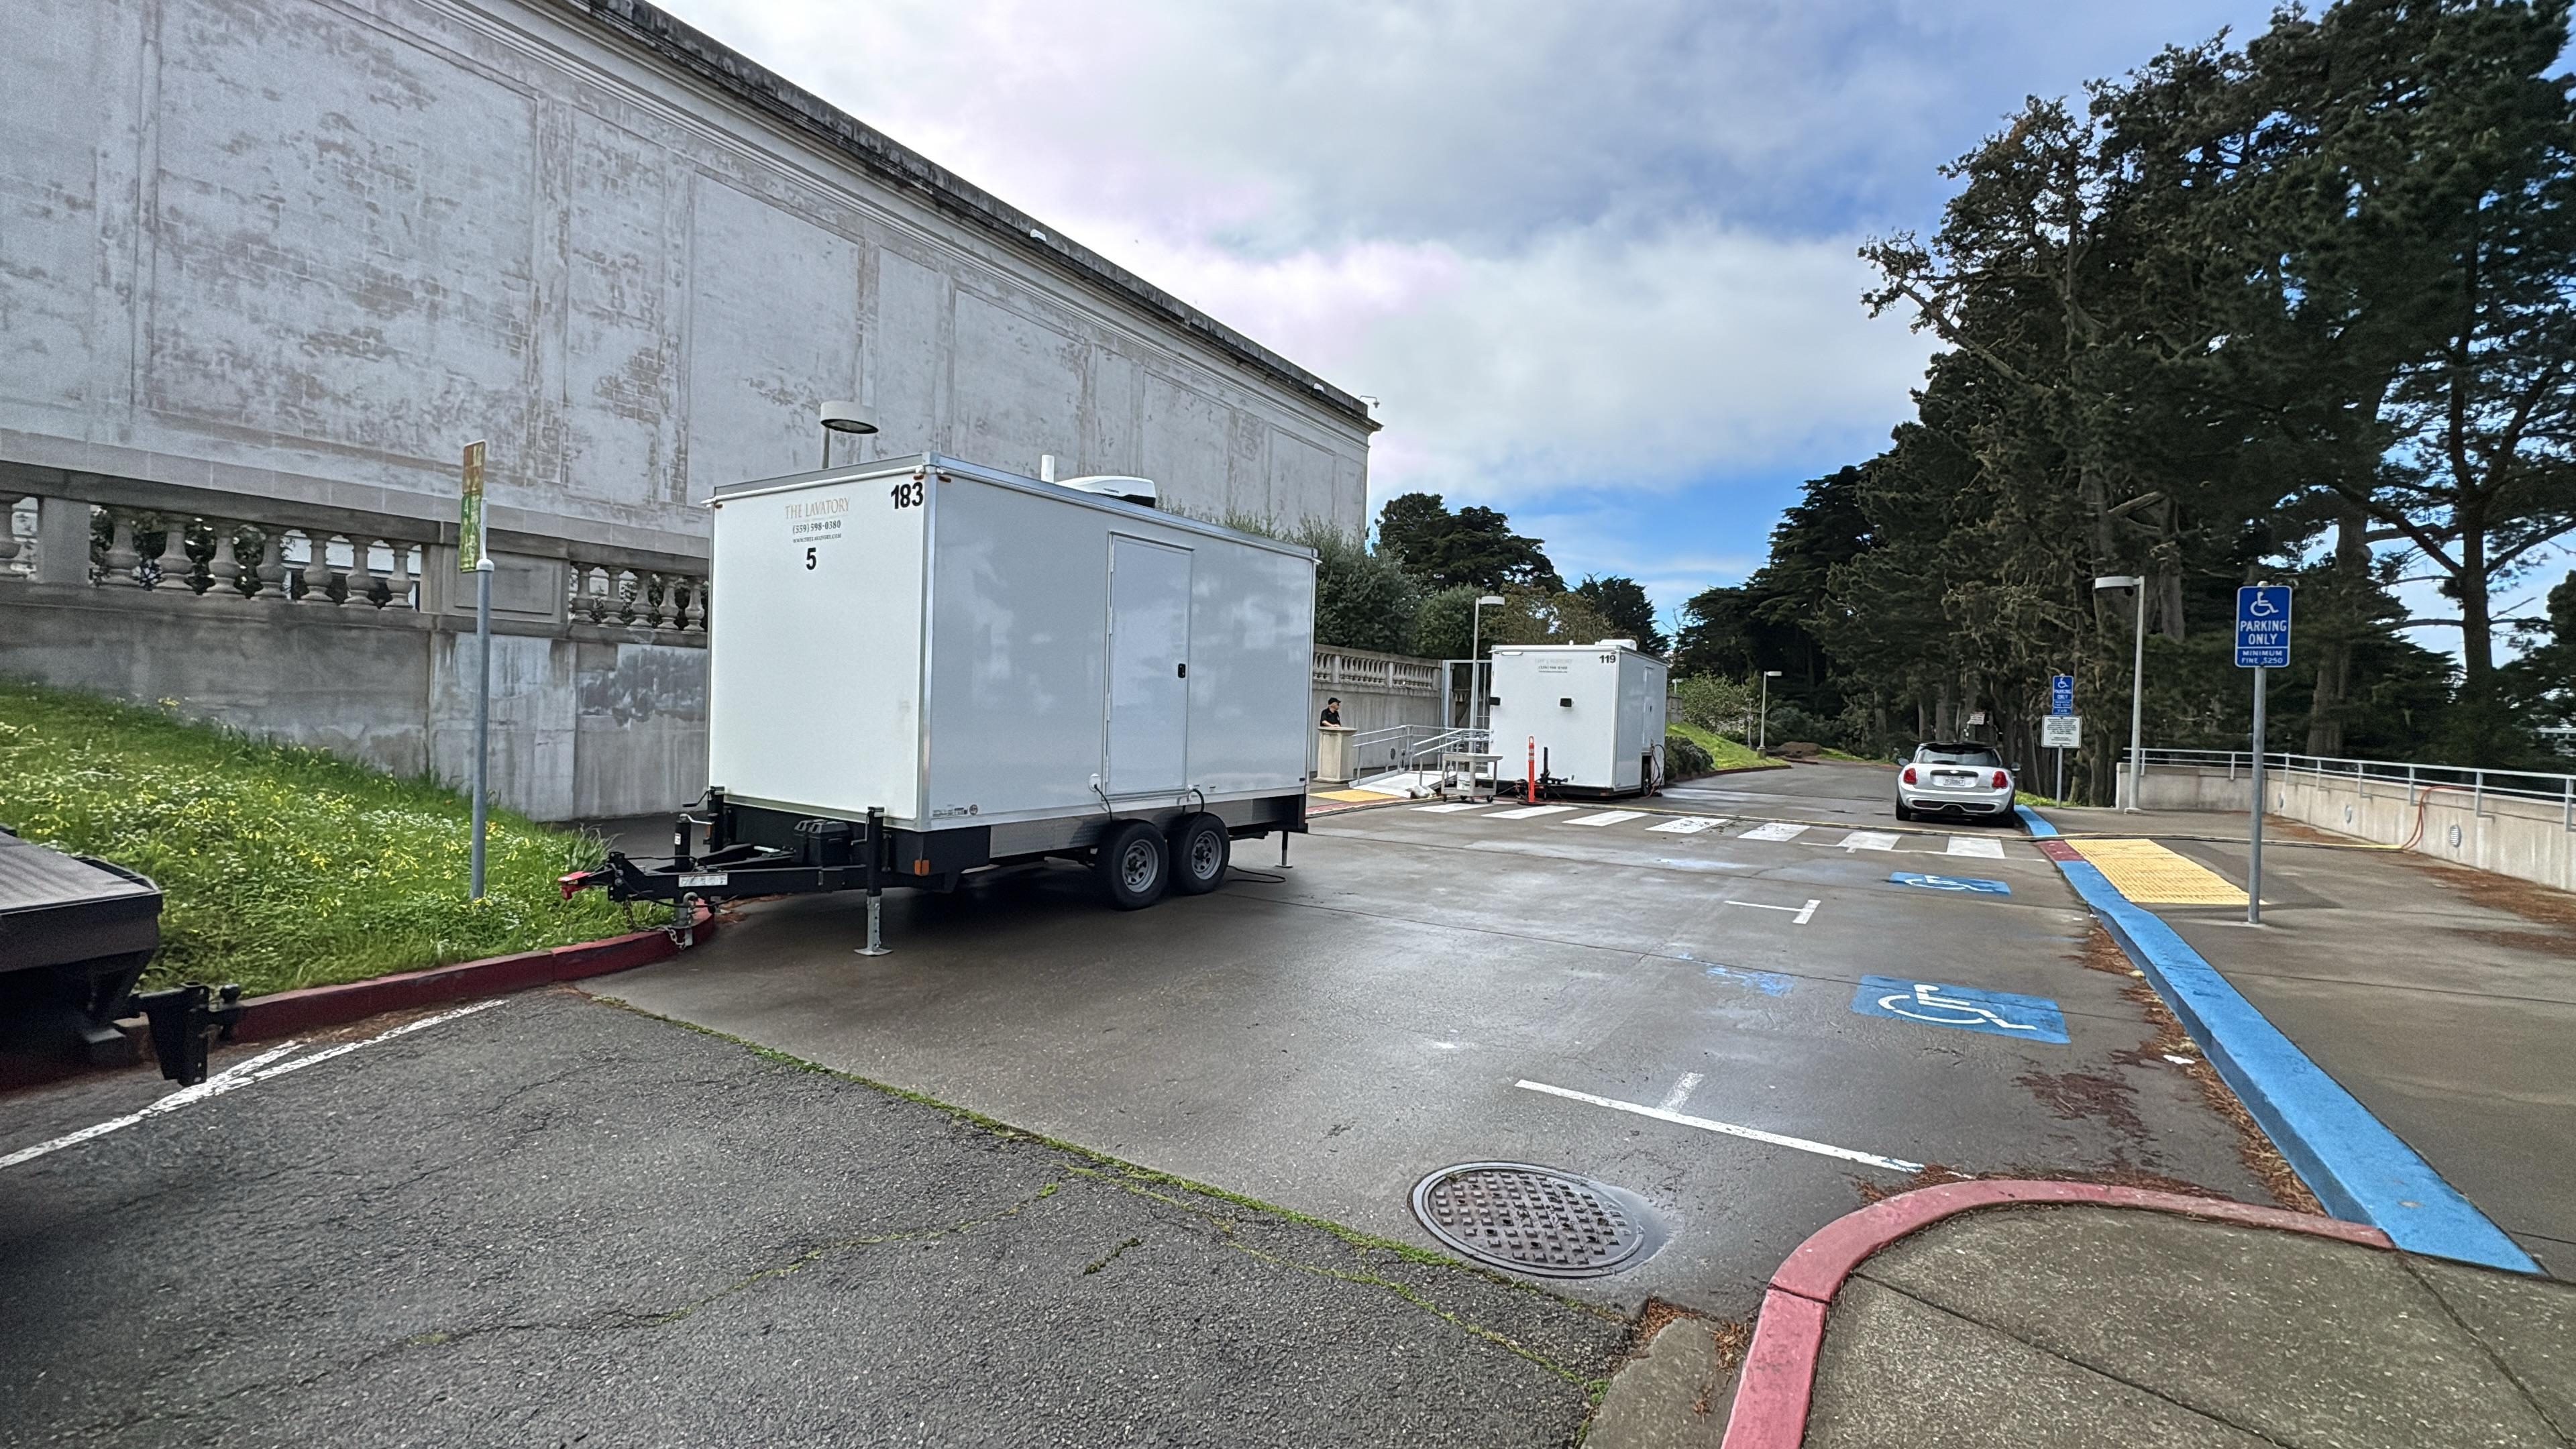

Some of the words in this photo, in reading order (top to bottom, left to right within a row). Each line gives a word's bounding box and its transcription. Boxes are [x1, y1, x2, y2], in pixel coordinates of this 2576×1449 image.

[891, 482, 923, 509] 183
[786, 504, 802, 519] THE
[806, 497, 850, 517] LAVATORY
[793, 523, 809, 534] (559)
[810, 520, 841, 532] 598-0380
[806, 547, 816, 570] 5
[2241, 620, 2287, 631] PARKING
[2249, 633, 2277, 645] ONLY
[1599, 655, 1616, 663] 119
